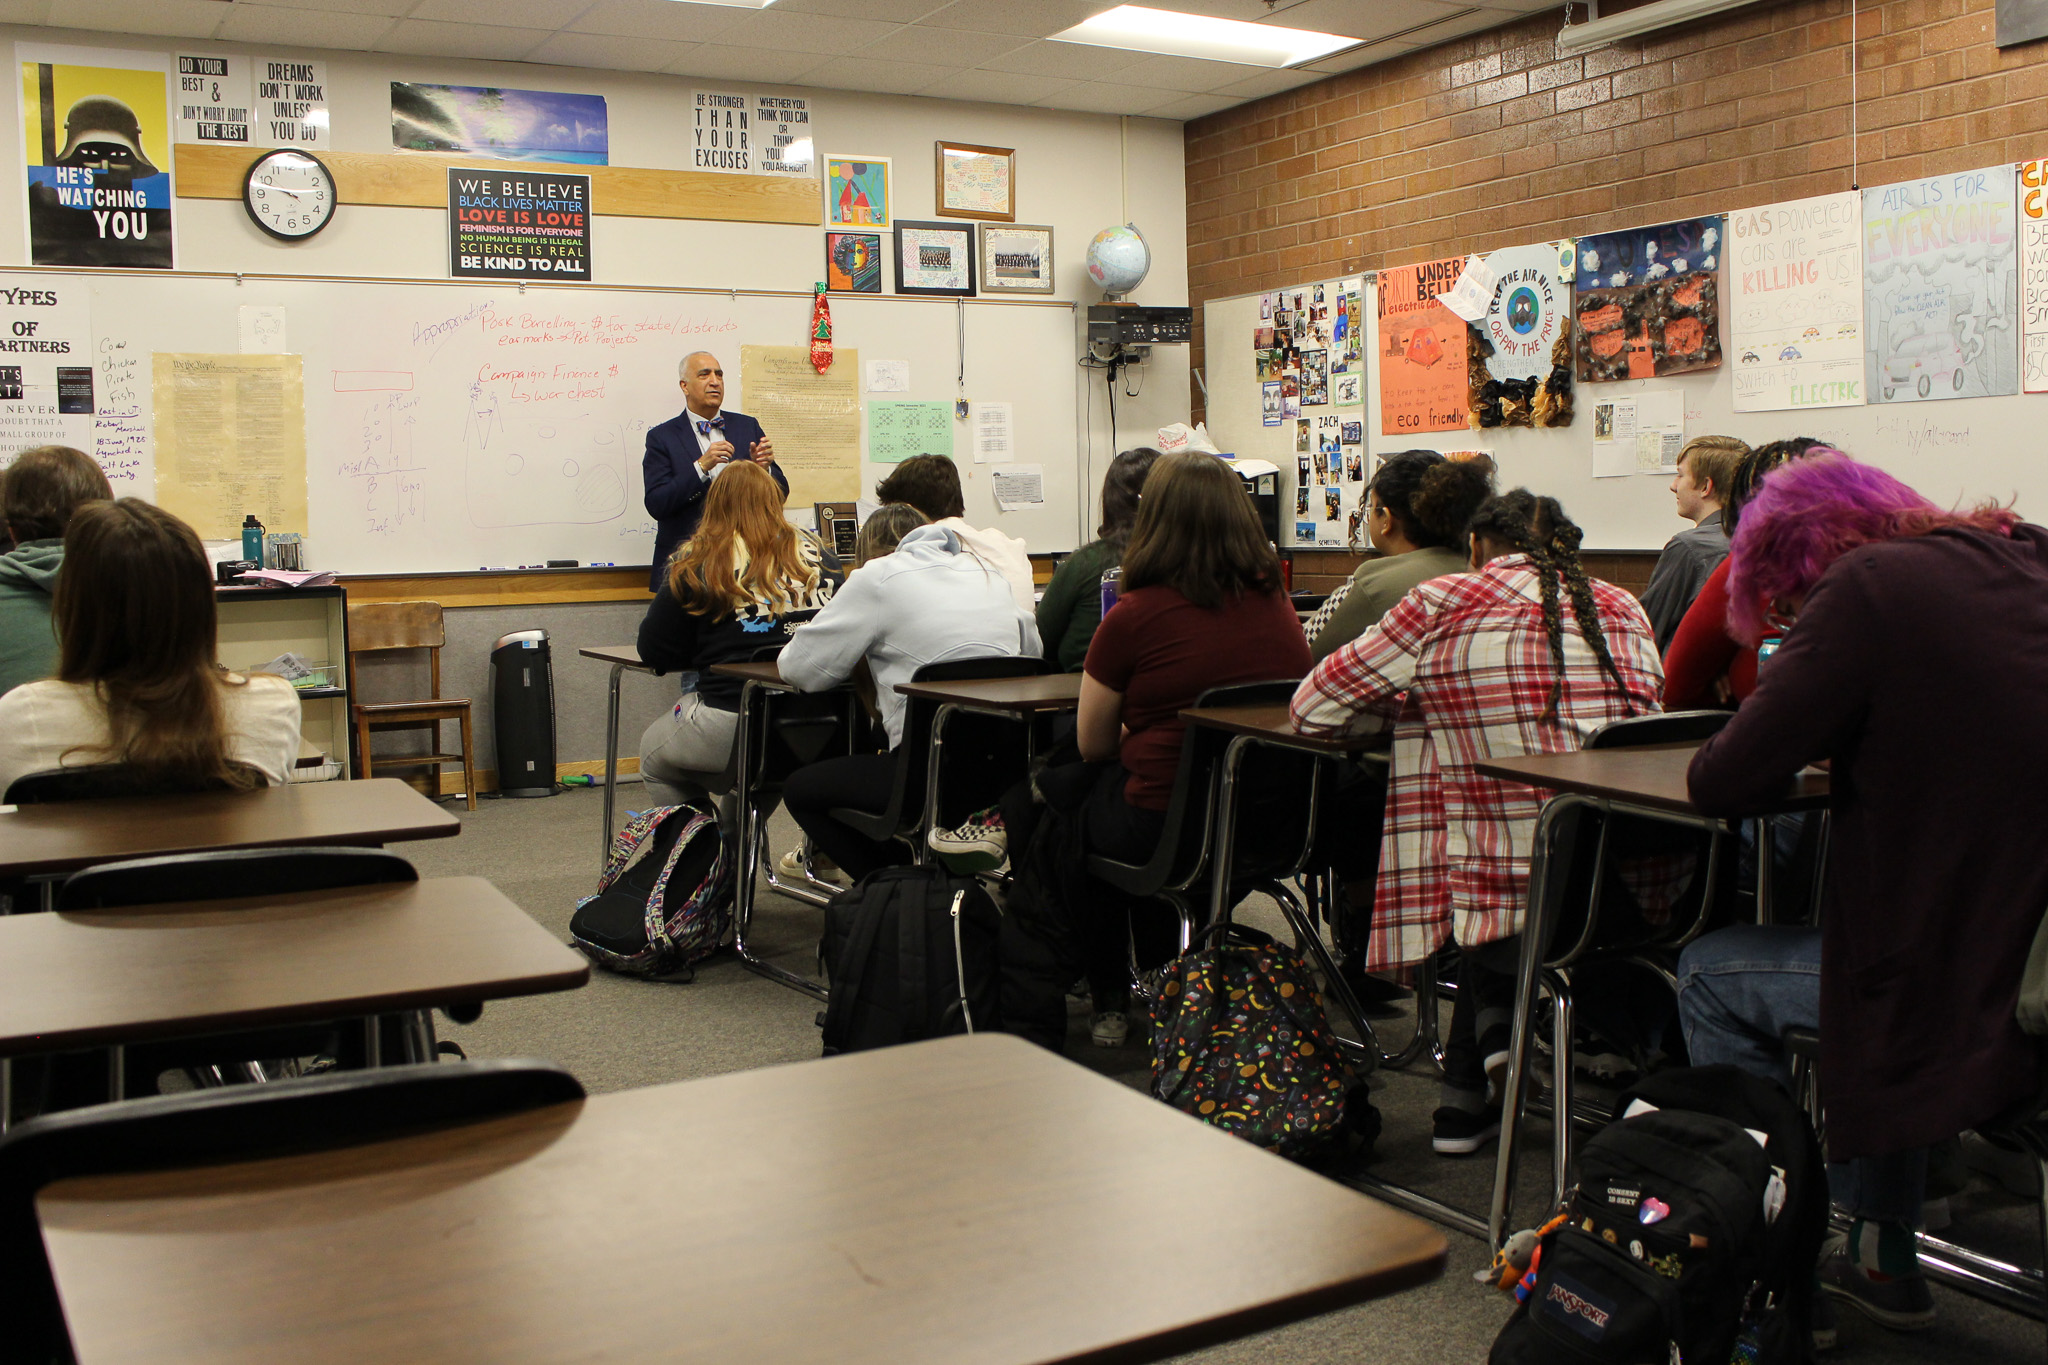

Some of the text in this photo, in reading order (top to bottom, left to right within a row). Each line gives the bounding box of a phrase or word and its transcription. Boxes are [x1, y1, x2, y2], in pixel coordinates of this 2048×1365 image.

[180, 58, 222, 75] DO YOUR
[268, 63, 313, 82] DREAMS
[182, 77, 204, 92] BEST
[211, 82, 221, 102] &
[260, 83, 323, 101] DON'T WORK
[697, 94, 744, 109] BE STRONGER
[760, 97, 805, 110] WHETHER YOU
[203, 107, 225, 122] WORRY
[228, 109, 247, 122] ABOUT
[273, 102, 310, 119] UNLESS
[695, 108, 747, 130] THAN
[757, 109, 808, 124] THINK YOU CAN
[199, 123, 244, 140] THE REST
[270, 121, 317, 141] YOU DO
[779, 125, 788, 134] OR
[695, 128, 747, 150] YOUR
[773, 135, 794, 147] THINK
[696, 149, 748, 170] EXCUSES
[765, 148, 780, 160] YOU
[56, 166, 94, 185] HE'S
[761, 161, 808, 173] YOU ARE RIGHT
[312, 177, 320, 187] 2
[458, 179, 582, 200] WE BELIEVE
[57, 187, 147, 208] WATCHING
[257, 189, 266, 199] 9
[316, 191, 324, 200] 3
[1881, 174, 1989, 212] AIR IS FOR
[262, 204, 270, 214] 8
[313, 205, 320, 214] 4
[460, 196, 583, 212] BLACK LIVES MATTER
[93, 210, 148, 240] YOU
[273, 215, 280, 224] 7
[288, 219, 296, 228] 6
[303, 216, 311, 225] 5
[458, 209, 583, 226] LOVE IS LOVE
[1735, 210, 1772, 238] GAS
[460, 224, 583, 237] FEMINISM IS FOR EVERYONE
[1866, 201, 2011, 264] EVERYONE
[512, 236, 538, 244] BEING
[550, 238, 583, 246] ILLEGAL
[460, 243, 584, 257] SCIENCE IS REAL
[1740, 243, 1774, 266] cars
[1782, 238, 1807, 260] are
[460, 255, 584, 272] BE KIND TO ALL
[1416, 260, 1460, 283] UNDER
[1742, 259, 1818, 294] KILLING
[1388, 270, 1410, 305] DIRTY
[1490, 268, 1554, 315] KEEP THE AIR NICE
[1389, 300, 1424, 315] electric
[12, 321, 39, 337] OF
[412, 299, 495, 347] Appropriations
[592, 314, 602, 330] $
[634, 313, 738, 336] state/districts
[498, 332, 554, 346] earmarks
[573, 330, 590, 345] Pet
[1490, 309, 1554, 357] OR PAY THE PRICE
[106, 370, 135, 389] Pirate
[478, 362, 619, 384] Campaign Finance $
[1782, 368, 1798, 384] to
[110, 387, 136, 404] Fish
[567, 380, 606, 400] chest
[1790, 381, 1859, 406] ELECTRIC
[6, 405, 56, 414] NEVER
[1397, 408, 1464, 427] eco friendly
[96, 419, 122, 428] Robert
[1319, 416, 1339, 428] ZACH
[96, 446, 131, 458] Lynched
[120, 460, 140, 468] Lake
[1607, 1187, 1640, 1199] CONSENT
[1547, 1282, 1610, 1328] JANSPORT
